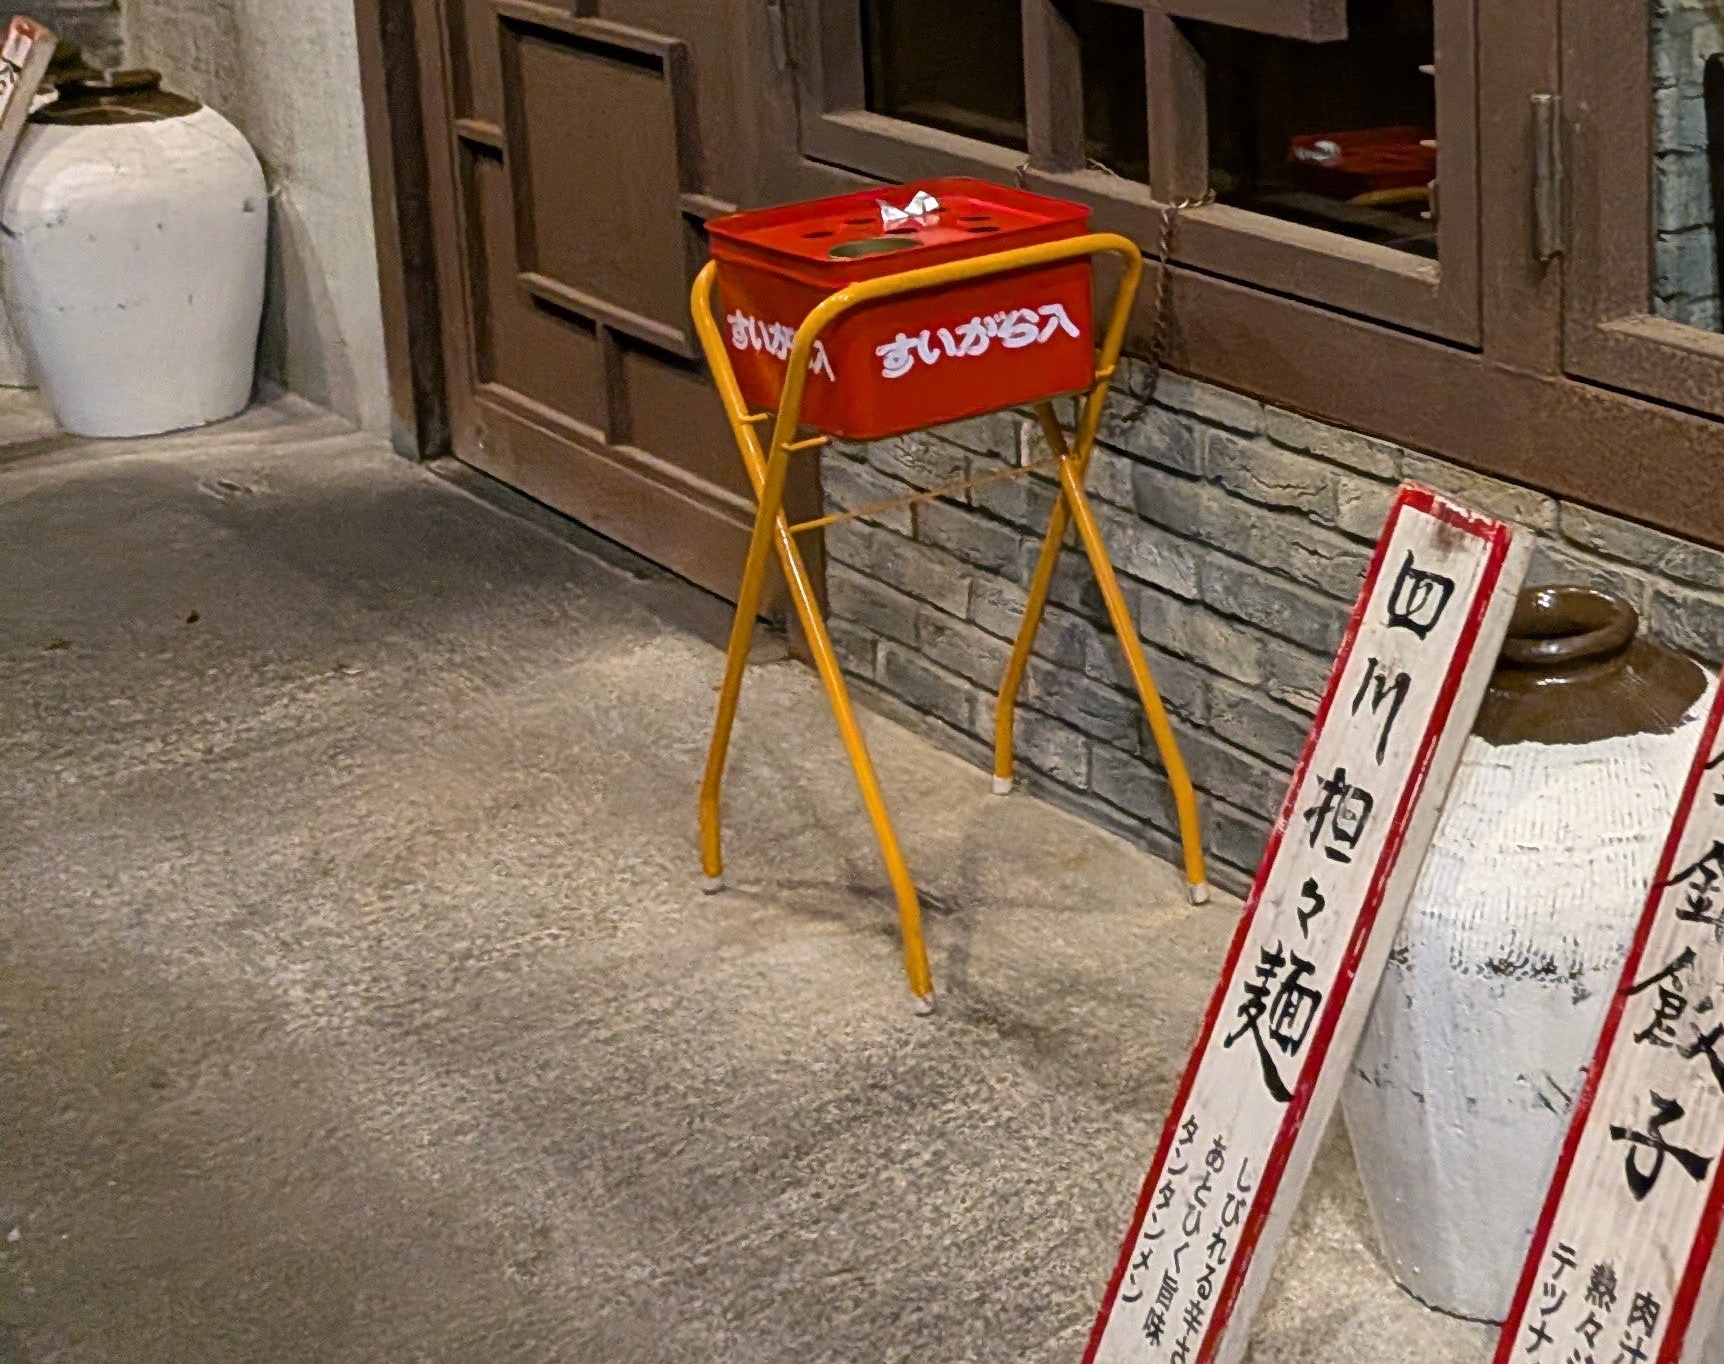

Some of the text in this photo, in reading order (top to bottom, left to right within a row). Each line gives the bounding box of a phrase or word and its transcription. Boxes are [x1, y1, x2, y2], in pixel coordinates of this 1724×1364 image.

[726, 309, 837, 382] すいが入
[875, 303, 1081, 379] すいがら入
[1223, 548, 1456, 1103] 四川担々麺
[1121, 1114, 1199, 1303] タンタンメン
[1525, 1242, 1577, 1364] テツナ
